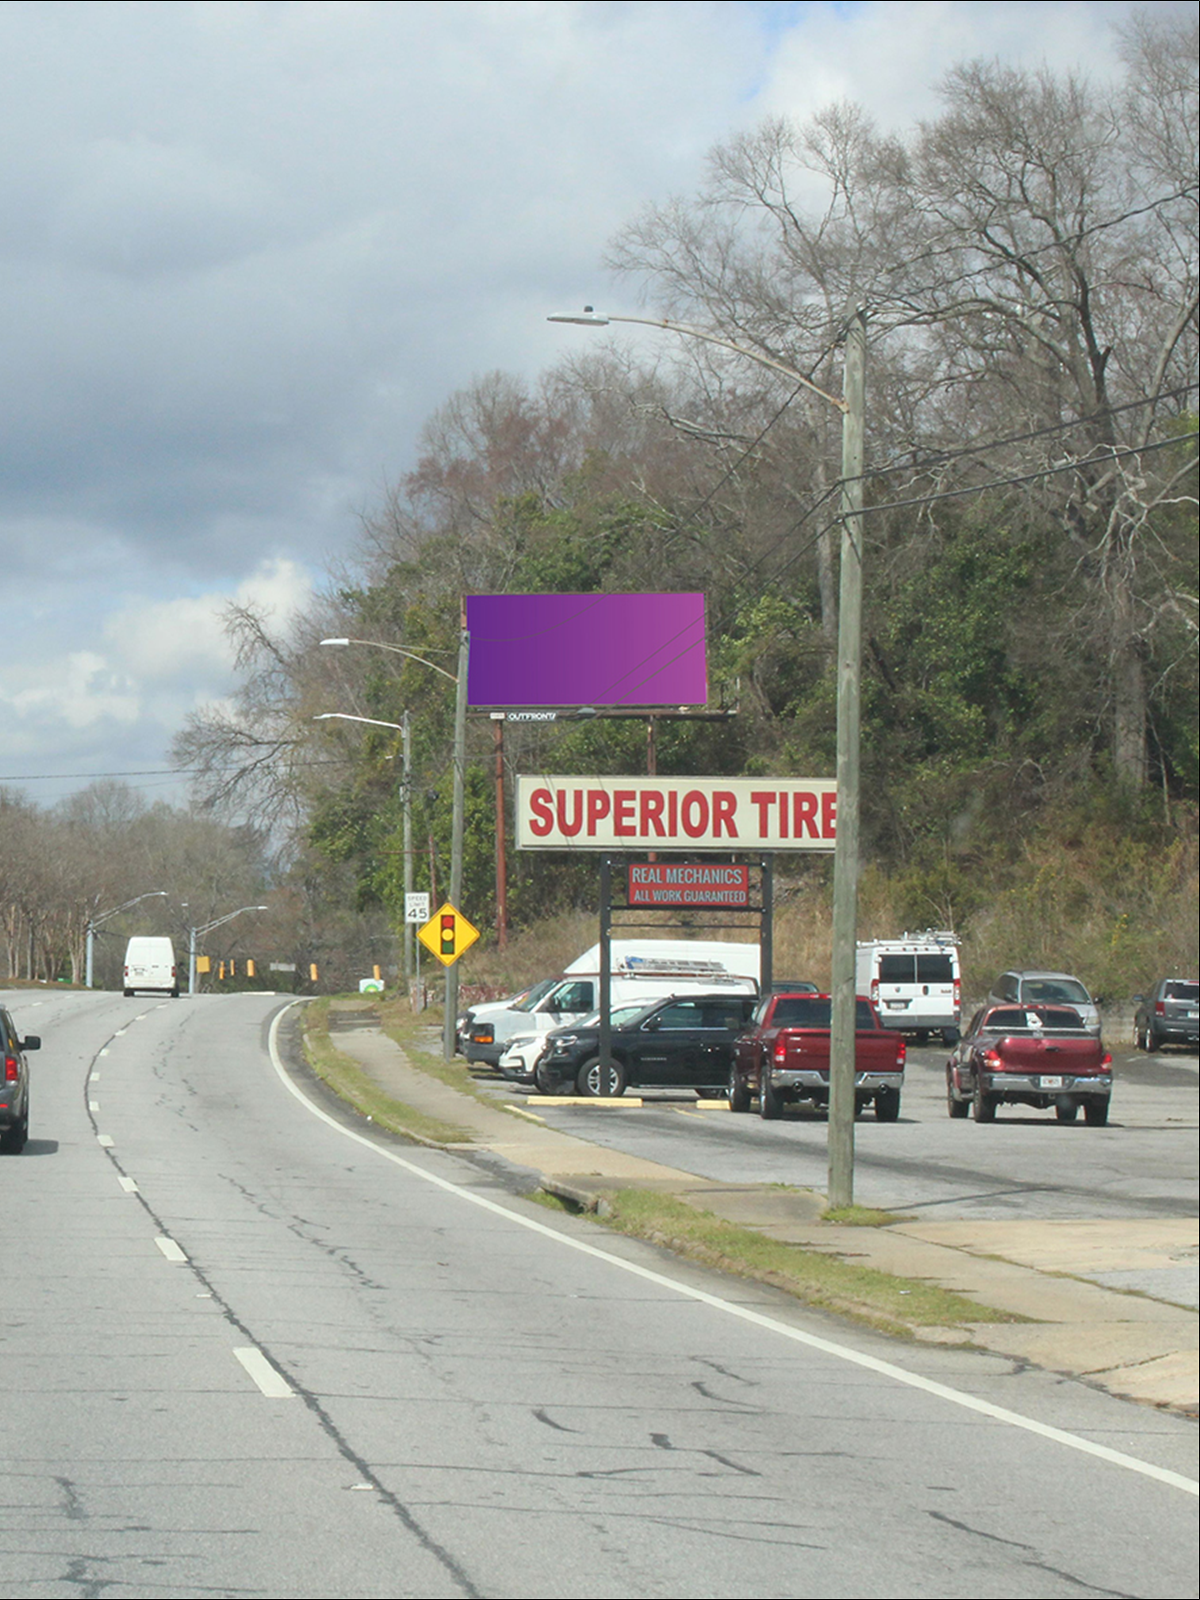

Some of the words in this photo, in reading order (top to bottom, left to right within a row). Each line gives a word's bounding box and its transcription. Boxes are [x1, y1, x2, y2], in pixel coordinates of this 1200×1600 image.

[529, 788, 738, 837] SUPERIOR
[751, 791, 837, 838] TIRE
[632, 867, 662, 883] REAL
[666, 868, 742, 884] MECHANICS
[634, 890, 650, 902] ALL
[653, 890, 681, 902] WORK
[684, 890, 746, 903] GUARANTEED
[408, 908, 427, 919] 45
